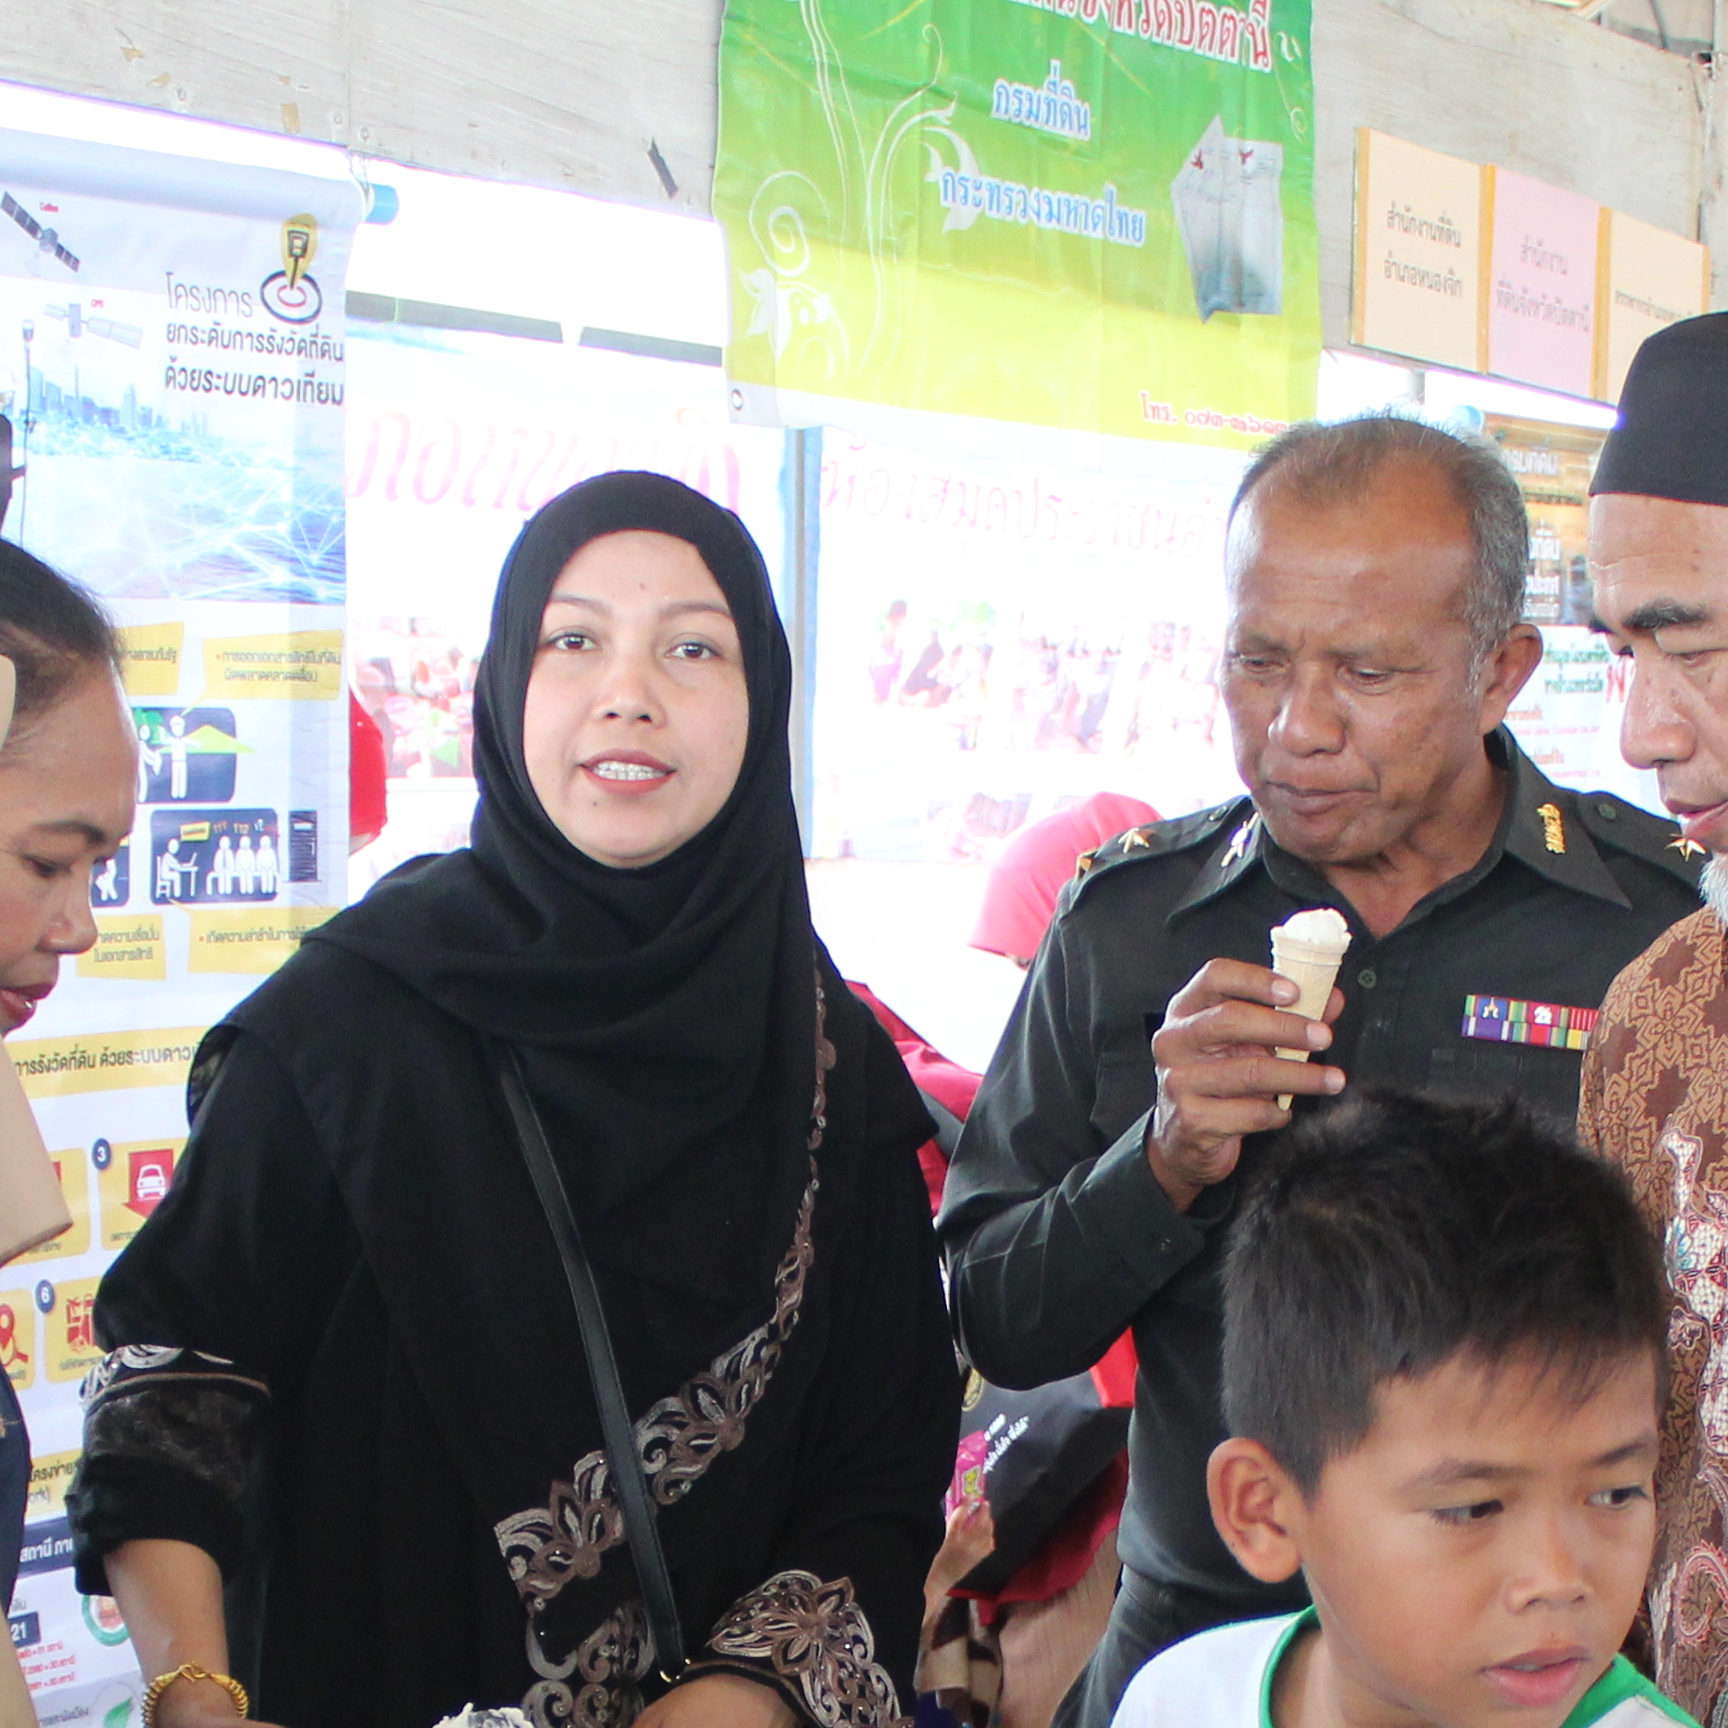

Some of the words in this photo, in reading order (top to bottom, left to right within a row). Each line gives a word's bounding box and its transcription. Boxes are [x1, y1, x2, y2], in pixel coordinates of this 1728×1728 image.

[993, 61, 1090, 139] กรมที่ดิน
[941, 171, 1145, 245] กระทรวงมหาดไทย
[164, 271, 254, 319] โครงการ
[165, 320, 344, 363] ยกระดับการรังวัดที่ดิน
[164, 354, 345, 407] ด้วยระบบดาวเทียม
[97, 1146, 107, 1163] 3
[41, 1286, 50, 1303] 6
